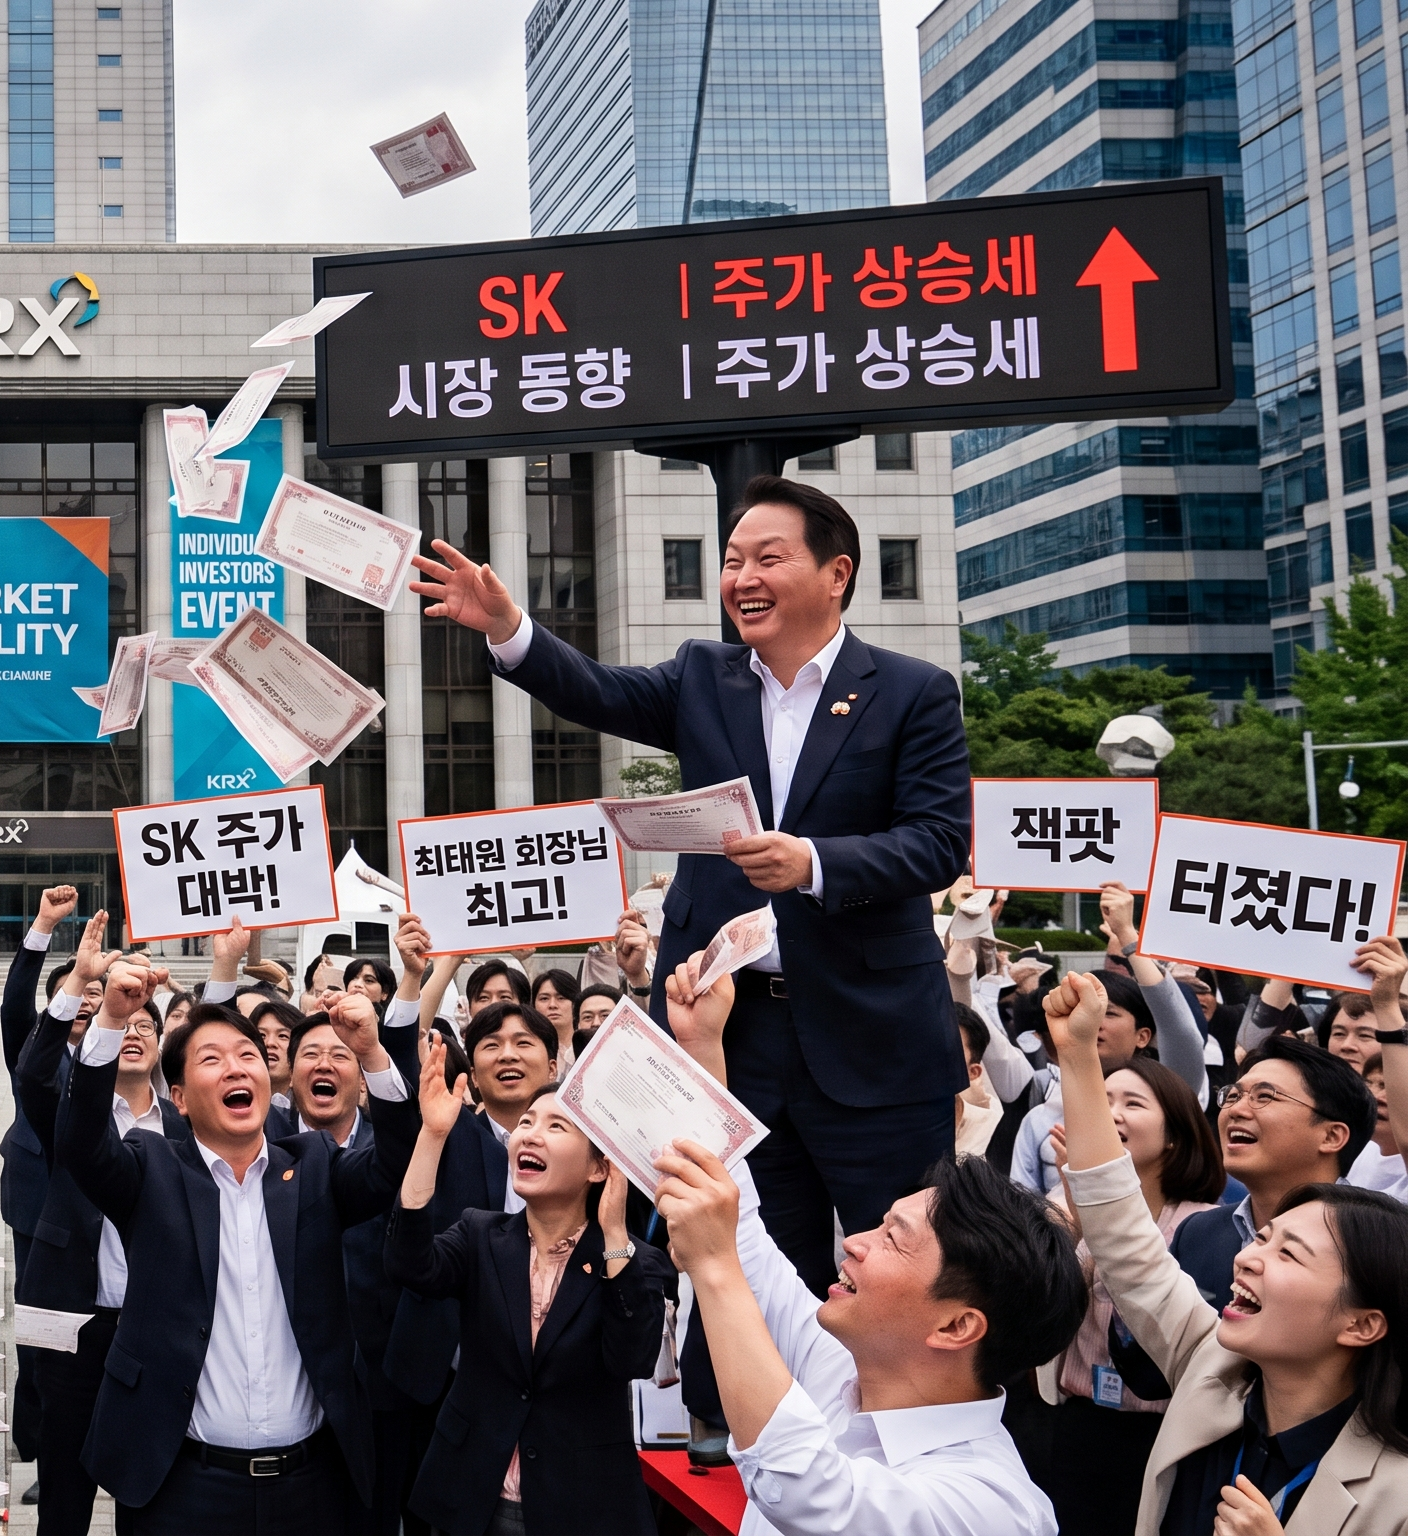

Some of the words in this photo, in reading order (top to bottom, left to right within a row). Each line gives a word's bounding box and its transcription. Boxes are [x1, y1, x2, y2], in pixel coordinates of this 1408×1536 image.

[480, 272, 567, 338] SK
[713, 253, 832, 318] 주가
[854, 235, 1036, 308] 상승세
[389, 358, 498, 418] 시장
[519, 348, 630, 412] 동향
[716, 333, 835, 398] 주가
[856, 317, 1040, 389] 상승세
[179, 533, 258, 555] INDIVIDU
[179, 561, 275, 584] INVESTORS
[207, 775, 251, 789] KRX
[142, 819, 205, 866] SK
[218, 806, 303, 858] 주가
[415, 838, 505, 876] 최태원
[515, 827, 607, 866] 회장님
[1011, 807, 1120, 863] 잭팟
[178, 865, 279, 916] 대박!
[467, 876, 567, 927] 최고!
[1170, 860, 1376, 942] 터졌다!
